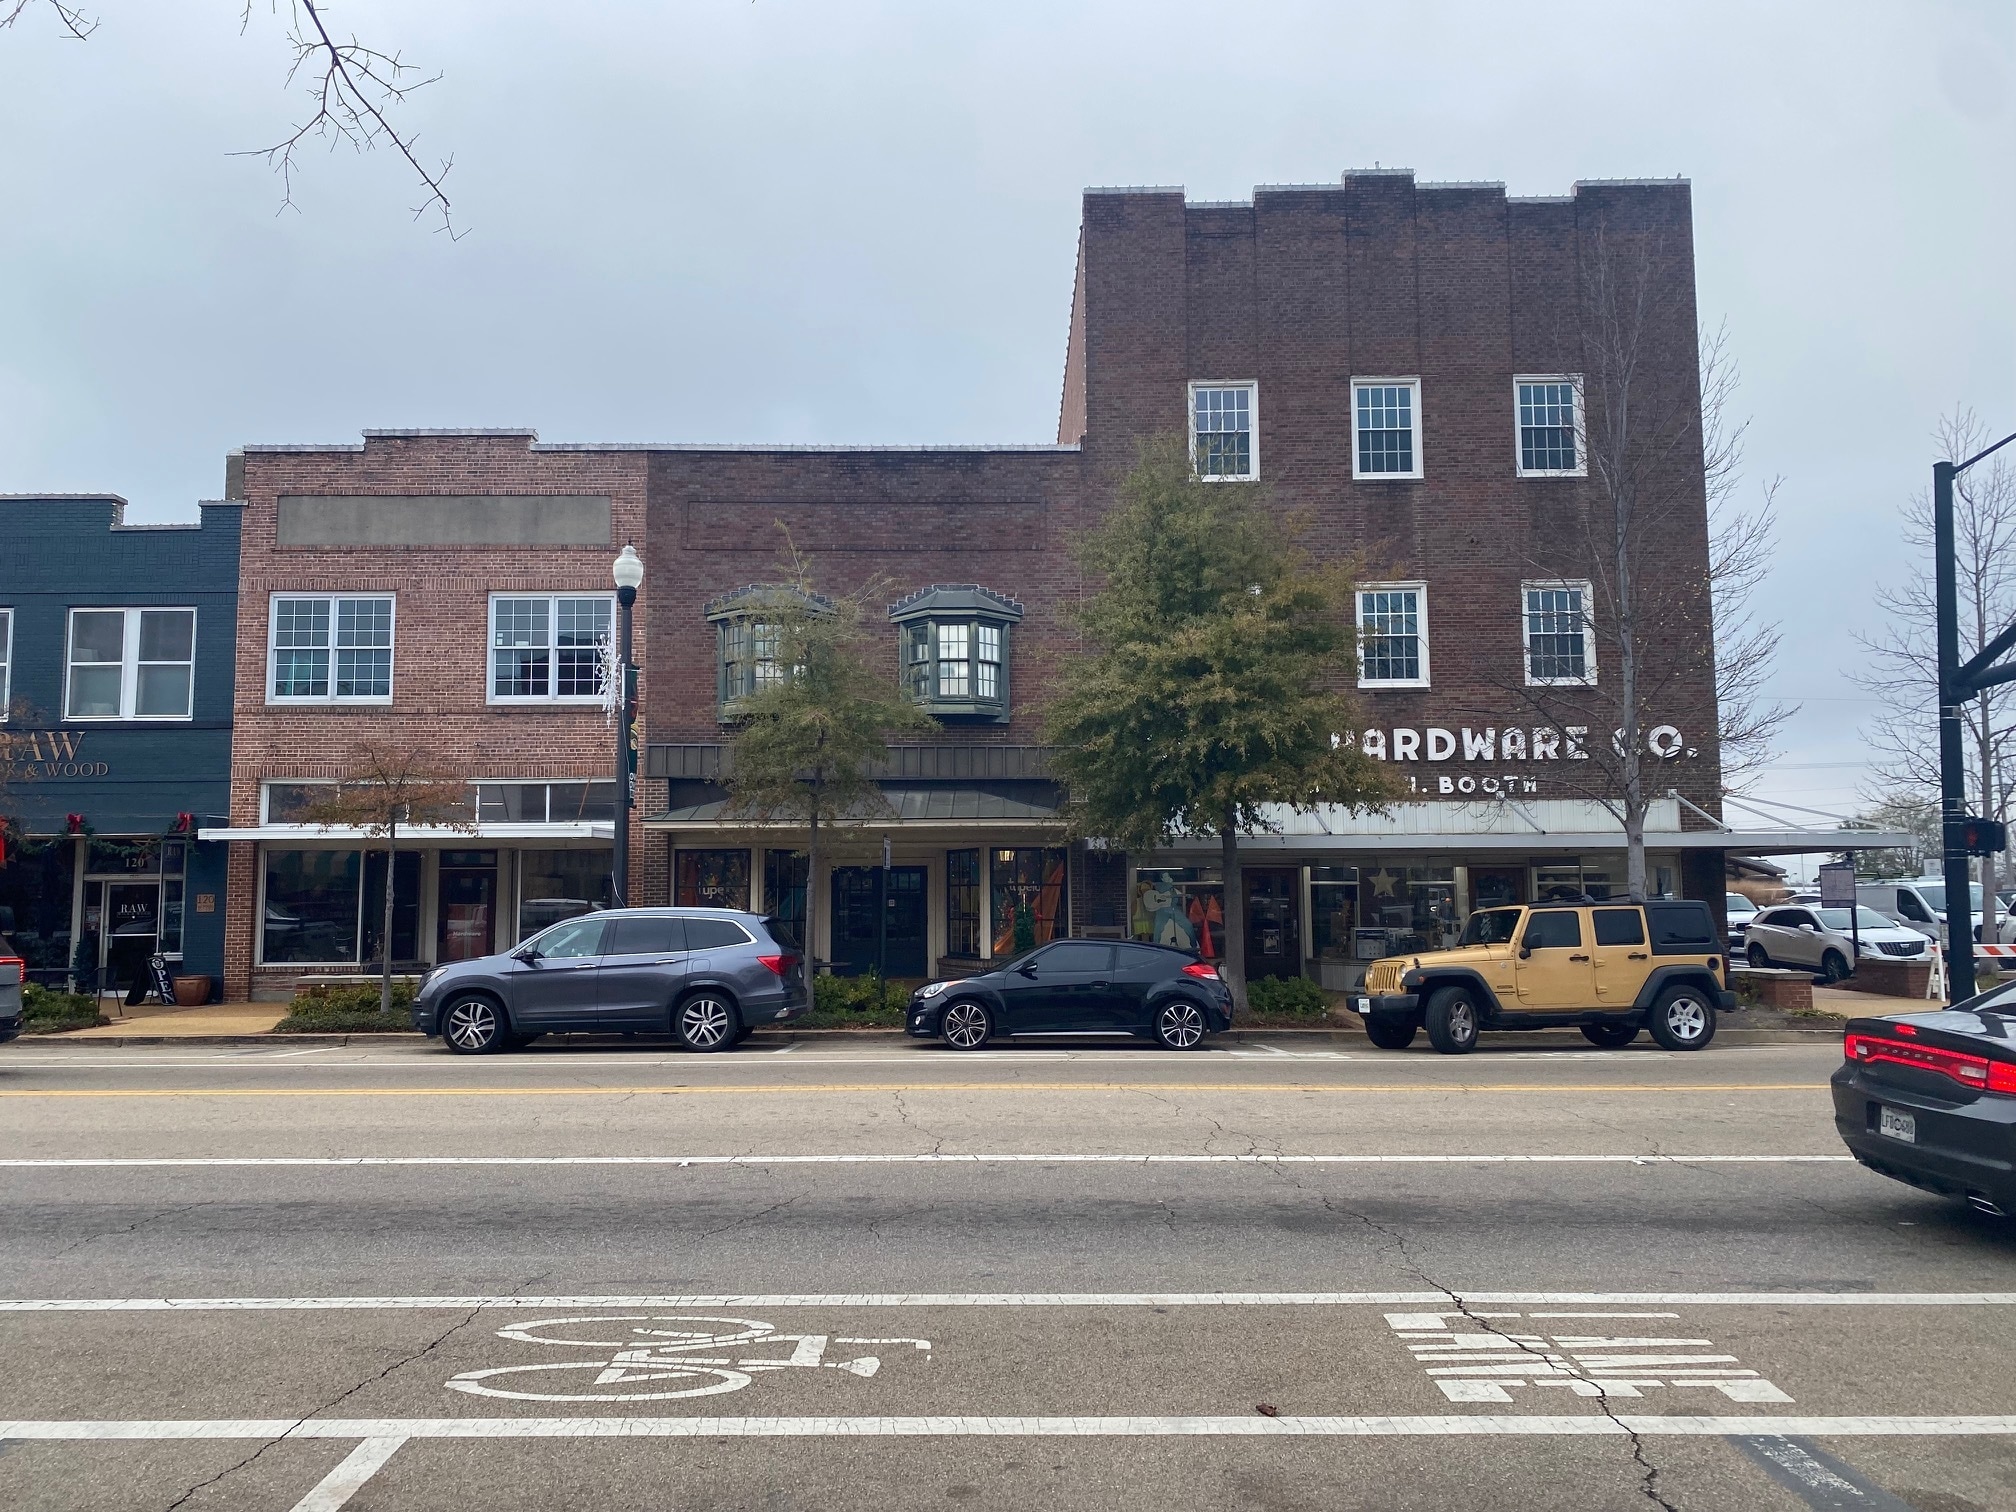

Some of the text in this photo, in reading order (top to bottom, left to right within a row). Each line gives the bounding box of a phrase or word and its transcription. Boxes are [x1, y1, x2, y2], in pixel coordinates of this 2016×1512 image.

[45, 762, 109, 777] WOOD
[1438, 775, 1537, 794] BOOTH
[126, 858, 145, 868] 120
[197, 895, 214, 904] 120
[121, 903, 148, 913] RAW
[152, 958, 176, 1004] OPEN
[1383, 1312, 1796, 1403] LANE
